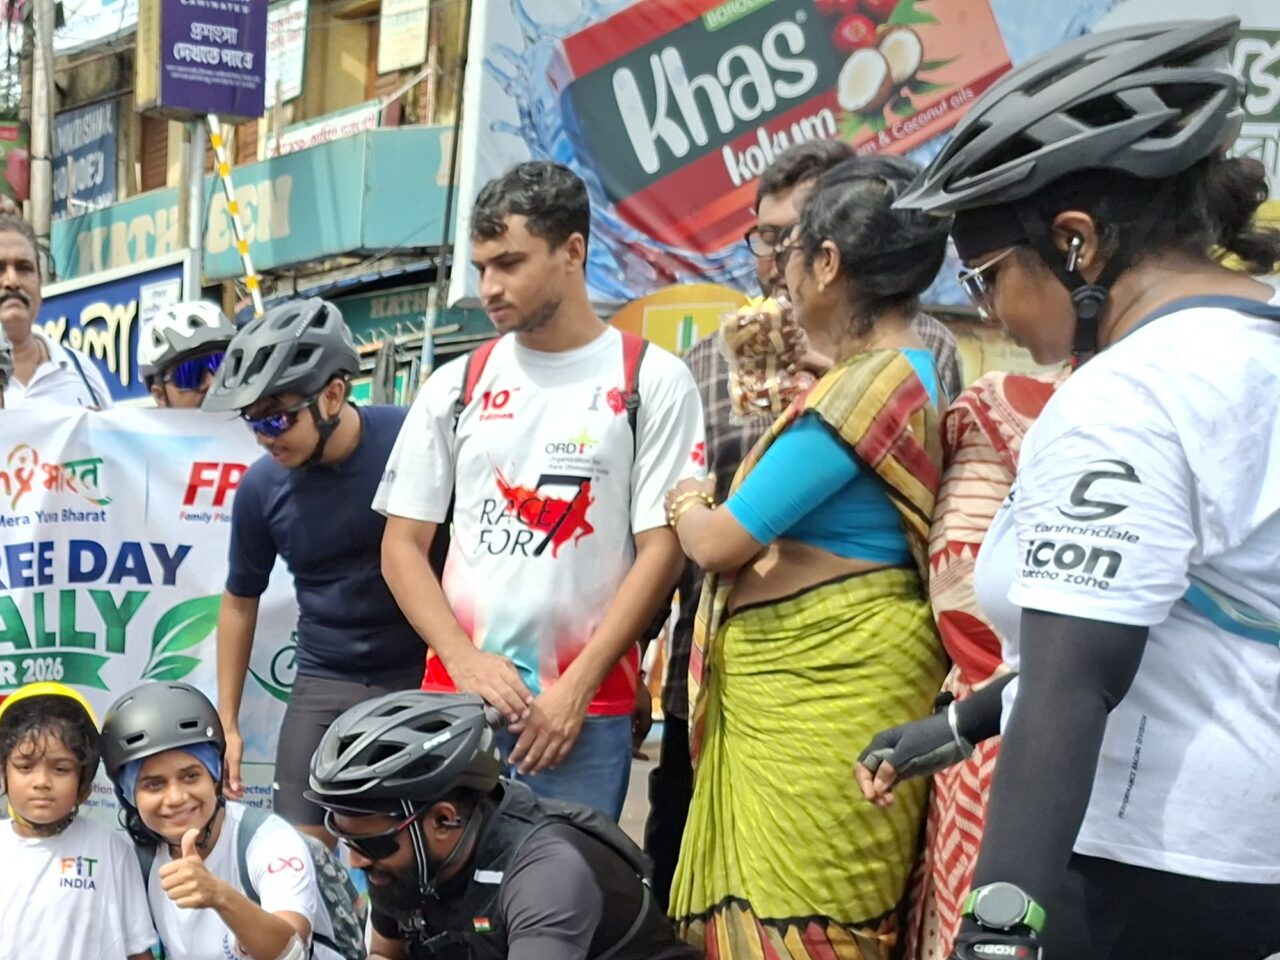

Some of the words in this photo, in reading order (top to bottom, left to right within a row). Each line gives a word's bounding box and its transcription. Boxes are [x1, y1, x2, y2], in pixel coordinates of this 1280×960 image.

[611, 20, 818, 175] Khas
[892, 100, 948, 140] Coconut
[950, 86, 974, 107] oils
[61, 509, 107, 523] Bharat
[479, 496, 556, 526] RACE
[477, 529, 534, 557] FOR
[1035, 524, 1140, 543] cannondale
[68, 539, 193, 588] DAY
[1025, 540, 1122, 579] icon
[1022, 569, 1059, 580] tattoo
[1064, 573, 1110, 590] zone
[61, 855, 98, 877] FIT
[59, 877, 97, 890] INDIA
